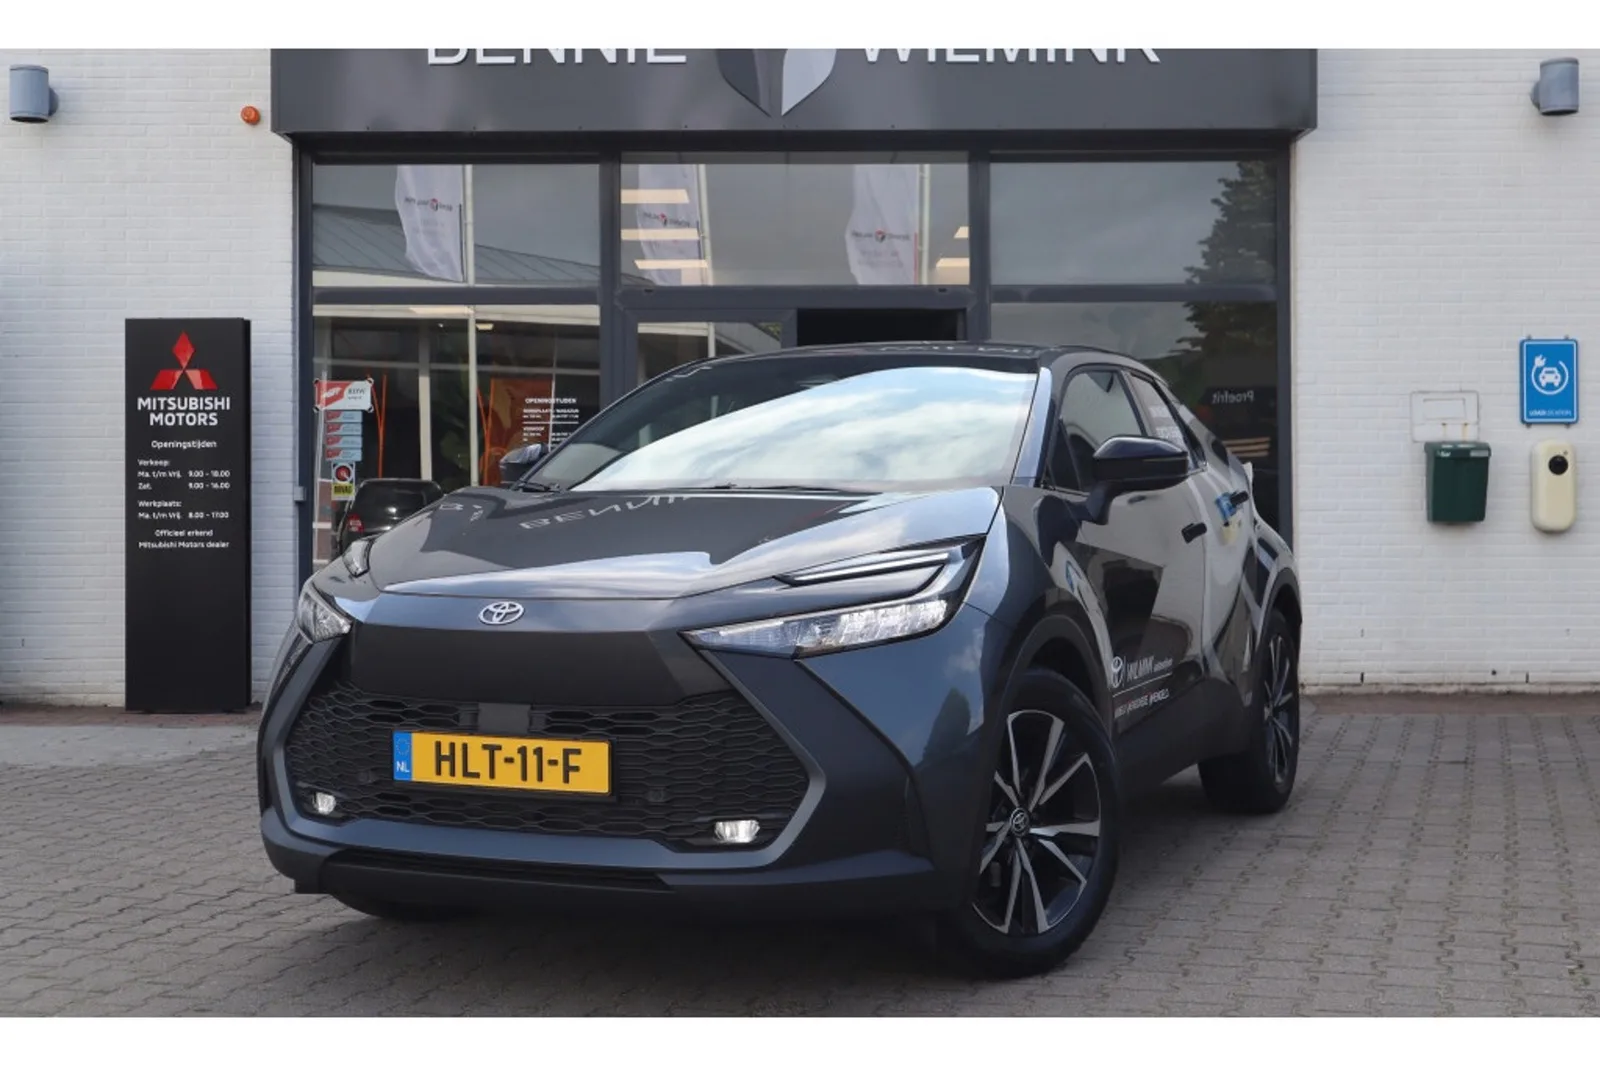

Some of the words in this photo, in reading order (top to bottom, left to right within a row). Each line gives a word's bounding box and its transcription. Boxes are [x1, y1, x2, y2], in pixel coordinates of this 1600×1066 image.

[137, 397, 231, 411] MITSUBISHI
[149, 413, 219, 426] MOTORS
[151, 440, 217, 450] Openingstijden
[154, 529, 186, 537] Officieel
[187, 529, 214, 537] erkend
[138, 541, 177, 549] Mitsubishi
[178, 541, 205, 549] Motors
[206, 541, 230, 549] dealer
[396, 760, 410, 773] NL
[434, 740, 582, 784] HLT-11-F
